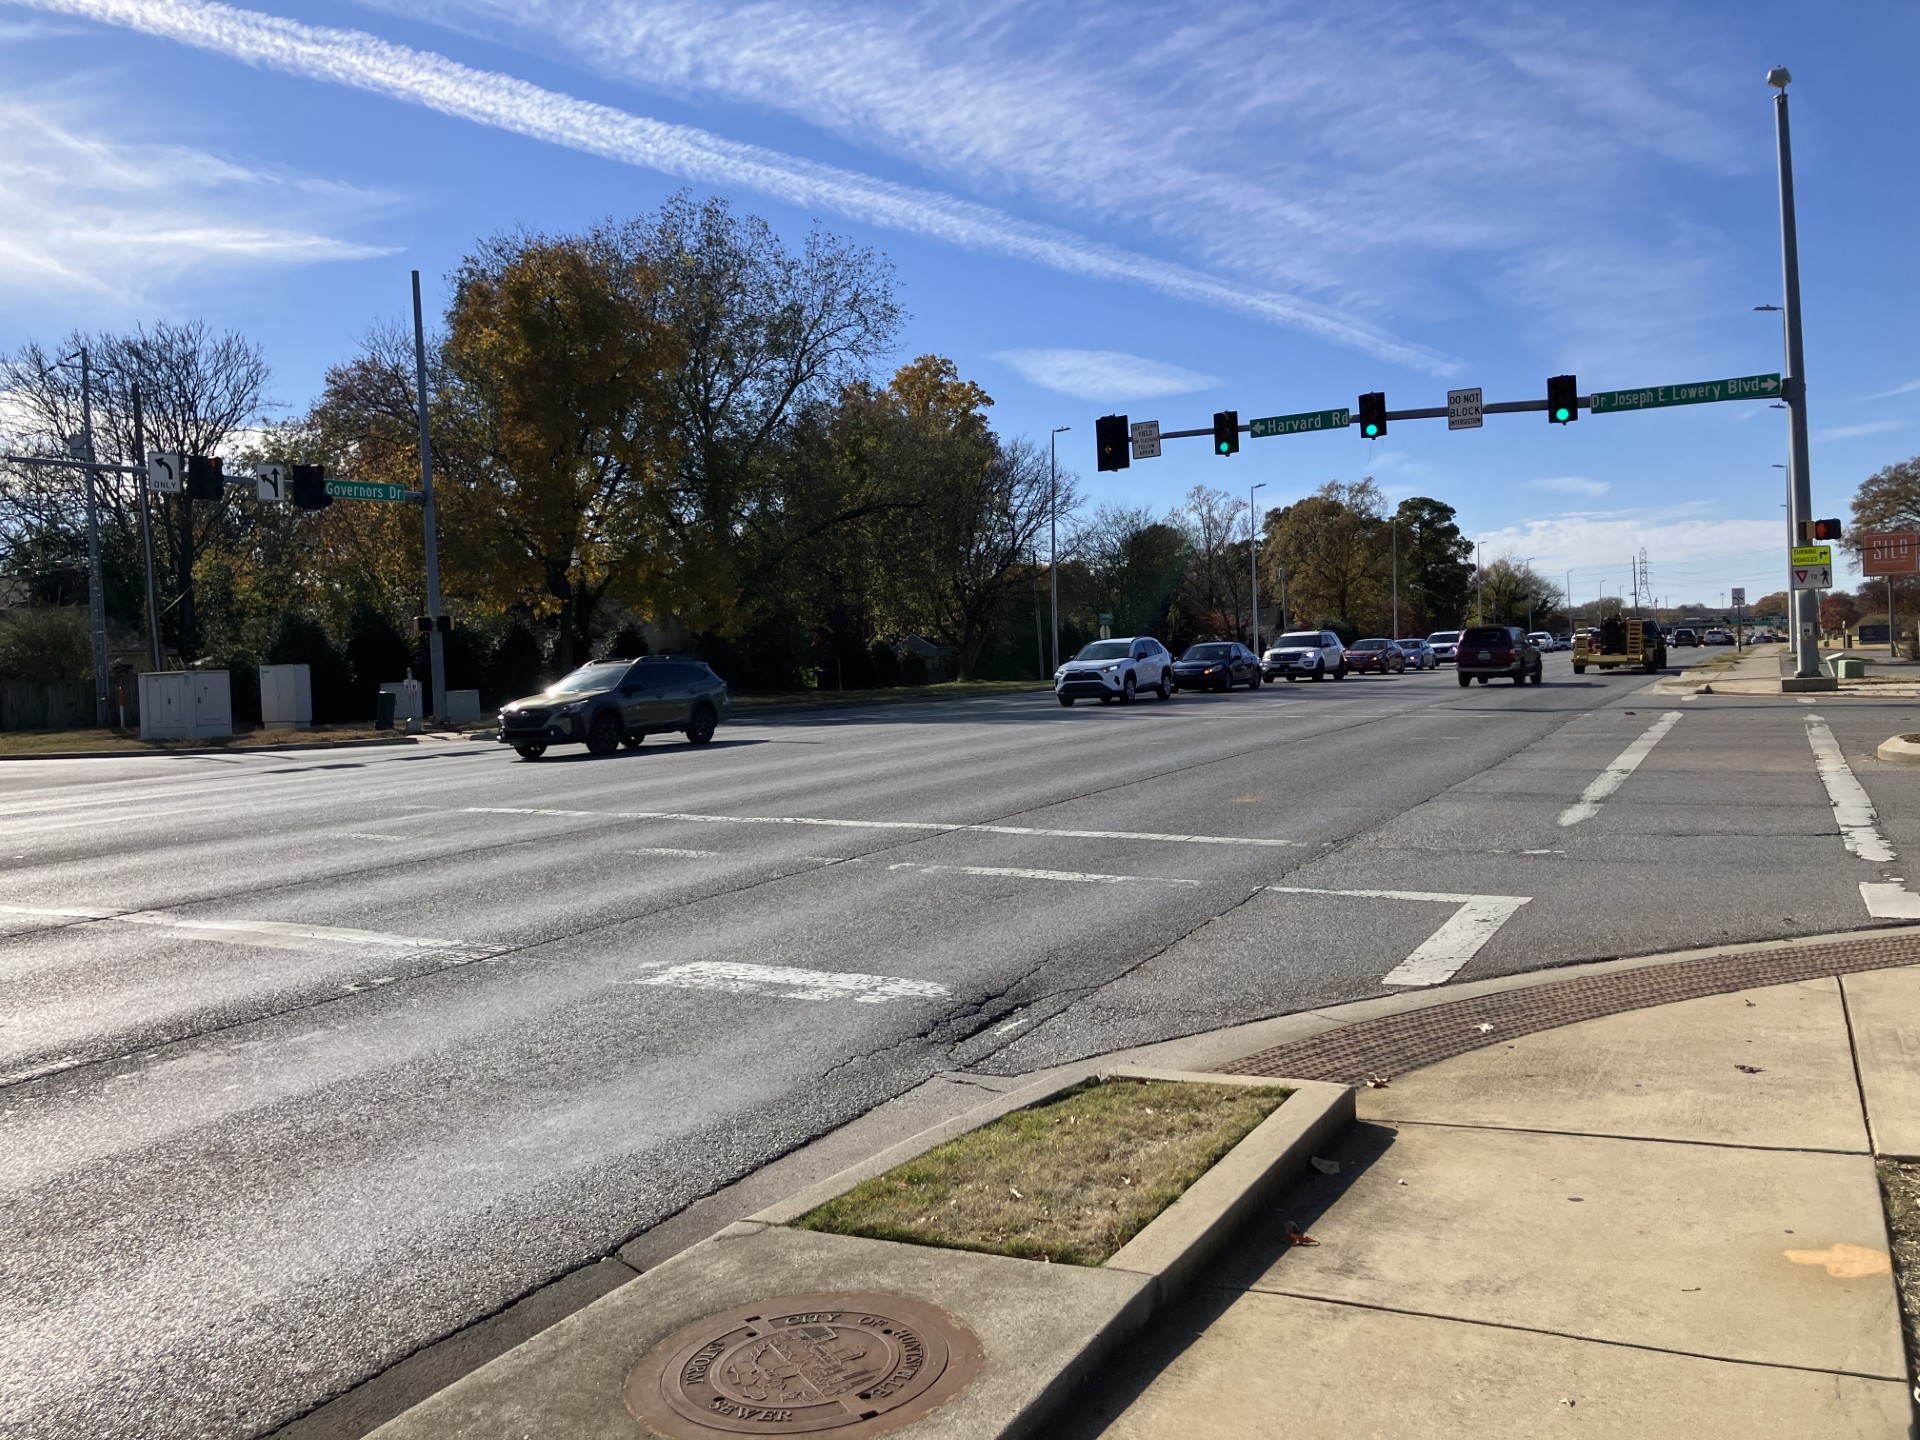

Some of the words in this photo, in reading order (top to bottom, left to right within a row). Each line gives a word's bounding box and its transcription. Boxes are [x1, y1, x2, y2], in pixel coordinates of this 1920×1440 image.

[1450, 396, 1461, 405] DO
[1464, 394, 1479, 403] NOT
[1612, 389, 1654, 407] Joseph
[1672, 385, 1720, 400] Lowery
[1727, 377, 1759, 394] Blvd
[1450, 407, 1480, 417] BLOCK
[1267, 414, 1321, 433] Harvard
[1332, 411, 1349, 426] Rd
[154, 480, 177, 489] ONLY
[326, 482, 384, 498] Governors
[389, 486, 402, 499] Dr
[1873, 538, 1908, 560] SILO
[785, 1313, 842, 1326] CITY
[858, 1316, 889, 1328] OF
[873, 1329, 924, 1398] HUNTSVILLE
[685, 1342, 725, 1386] STORM
[708, 1400, 793, 1422] SEWER
